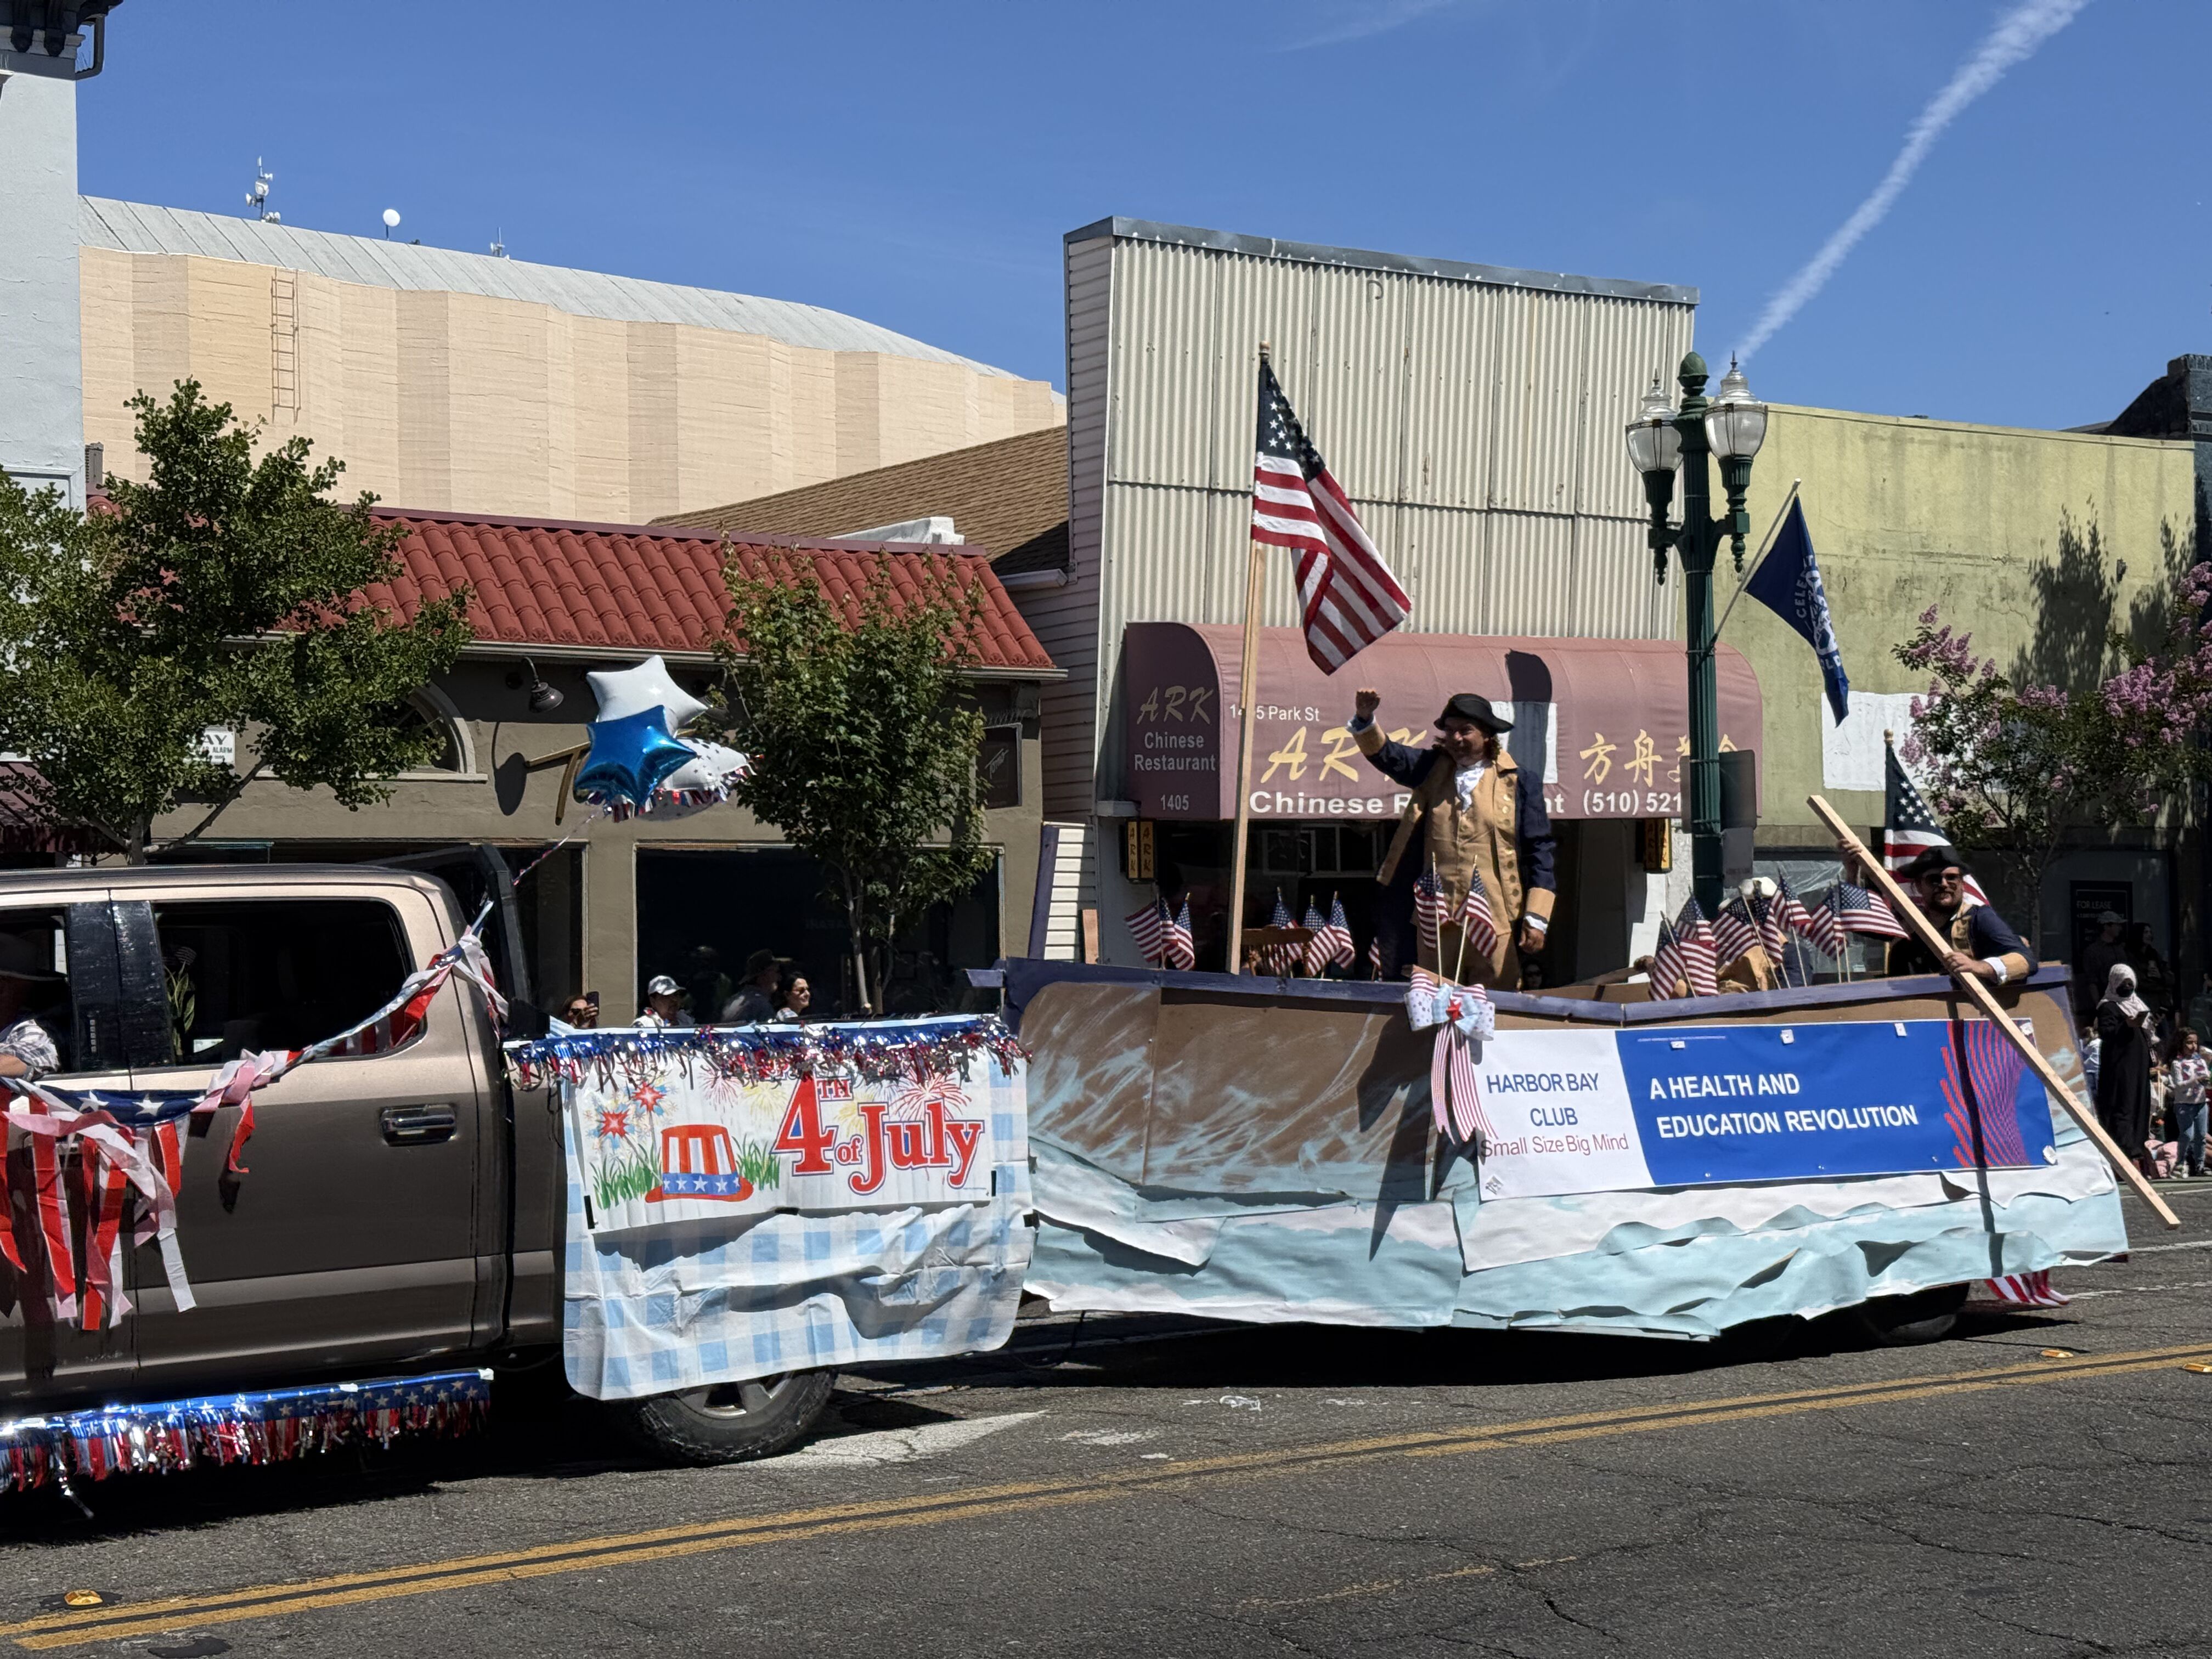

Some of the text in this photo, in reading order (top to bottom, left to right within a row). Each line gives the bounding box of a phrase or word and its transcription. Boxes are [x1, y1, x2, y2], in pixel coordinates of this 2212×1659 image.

[1137, 685, 1215, 725] ARK
[1230, 704, 1320, 721] 15 Park St
[201, 735, 228, 745] AY
[1144, 731, 1204, 749] Chinese
[1135, 754, 1216, 771] Restaurant
[1160, 795, 1189, 811] 1405
[1250, 791, 1383, 814] Chinese
[1583, 790, 1639, 815] (510)
[1143, 827, 1151, 872] ARK
[2090, 901, 2112, 909] LEASE
[1486, 1073, 1599, 1093] HARBOR BAY
[1650, 1073, 1799, 1099] A HEALTH AND
[1530, 1108, 1578, 1127] CLUB
[1657, 1105, 1919, 1138] EDUCATION REVOLUTION
[835, 1135, 864, 1165] of
[848, 1100, 985, 1196] July
[1481, 1133, 1629, 1157] Small Size Big Mind
